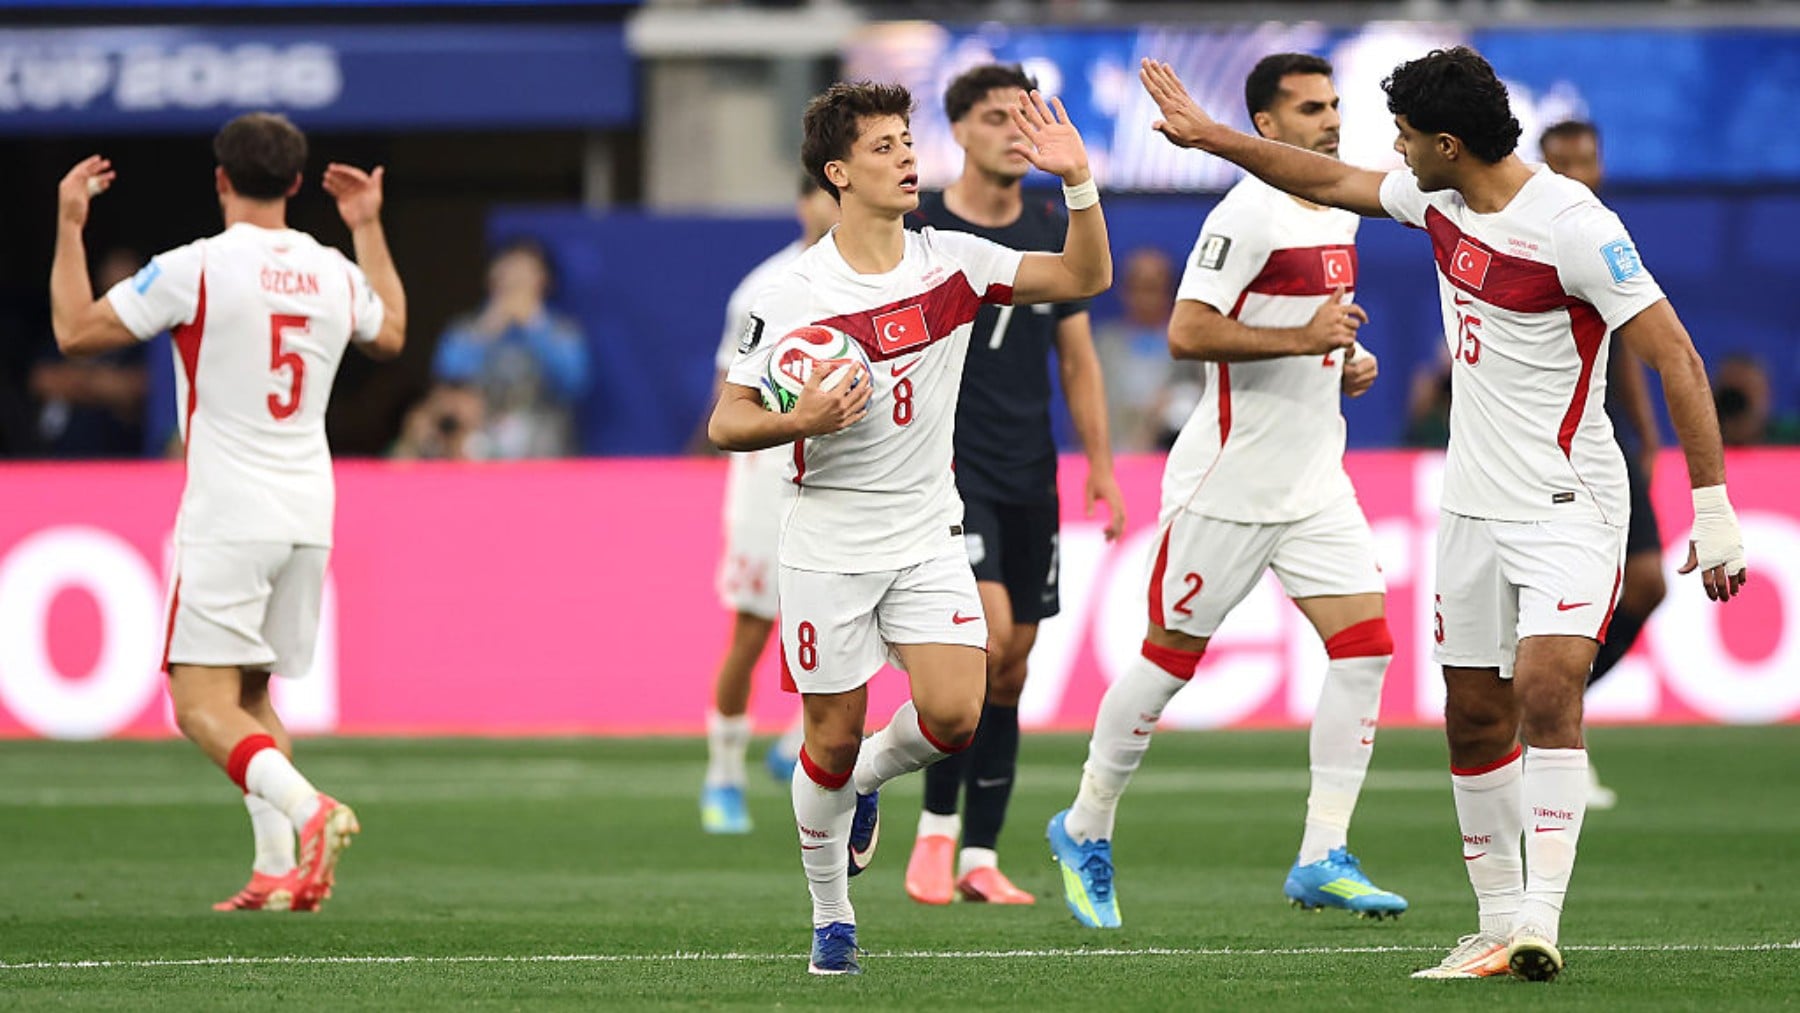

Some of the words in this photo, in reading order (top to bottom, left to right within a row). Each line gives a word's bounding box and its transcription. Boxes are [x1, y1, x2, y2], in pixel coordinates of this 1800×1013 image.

[117, 43, 342, 108] 2026
[261, 266, 319, 296] ÖZCAN
[1455, 311, 1481, 366] 15
[267, 314, 309, 421] 5
[893, 376, 914, 427] 8
[1172, 572, 1204, 619] 2
[798, 620, 819, 673] 8
